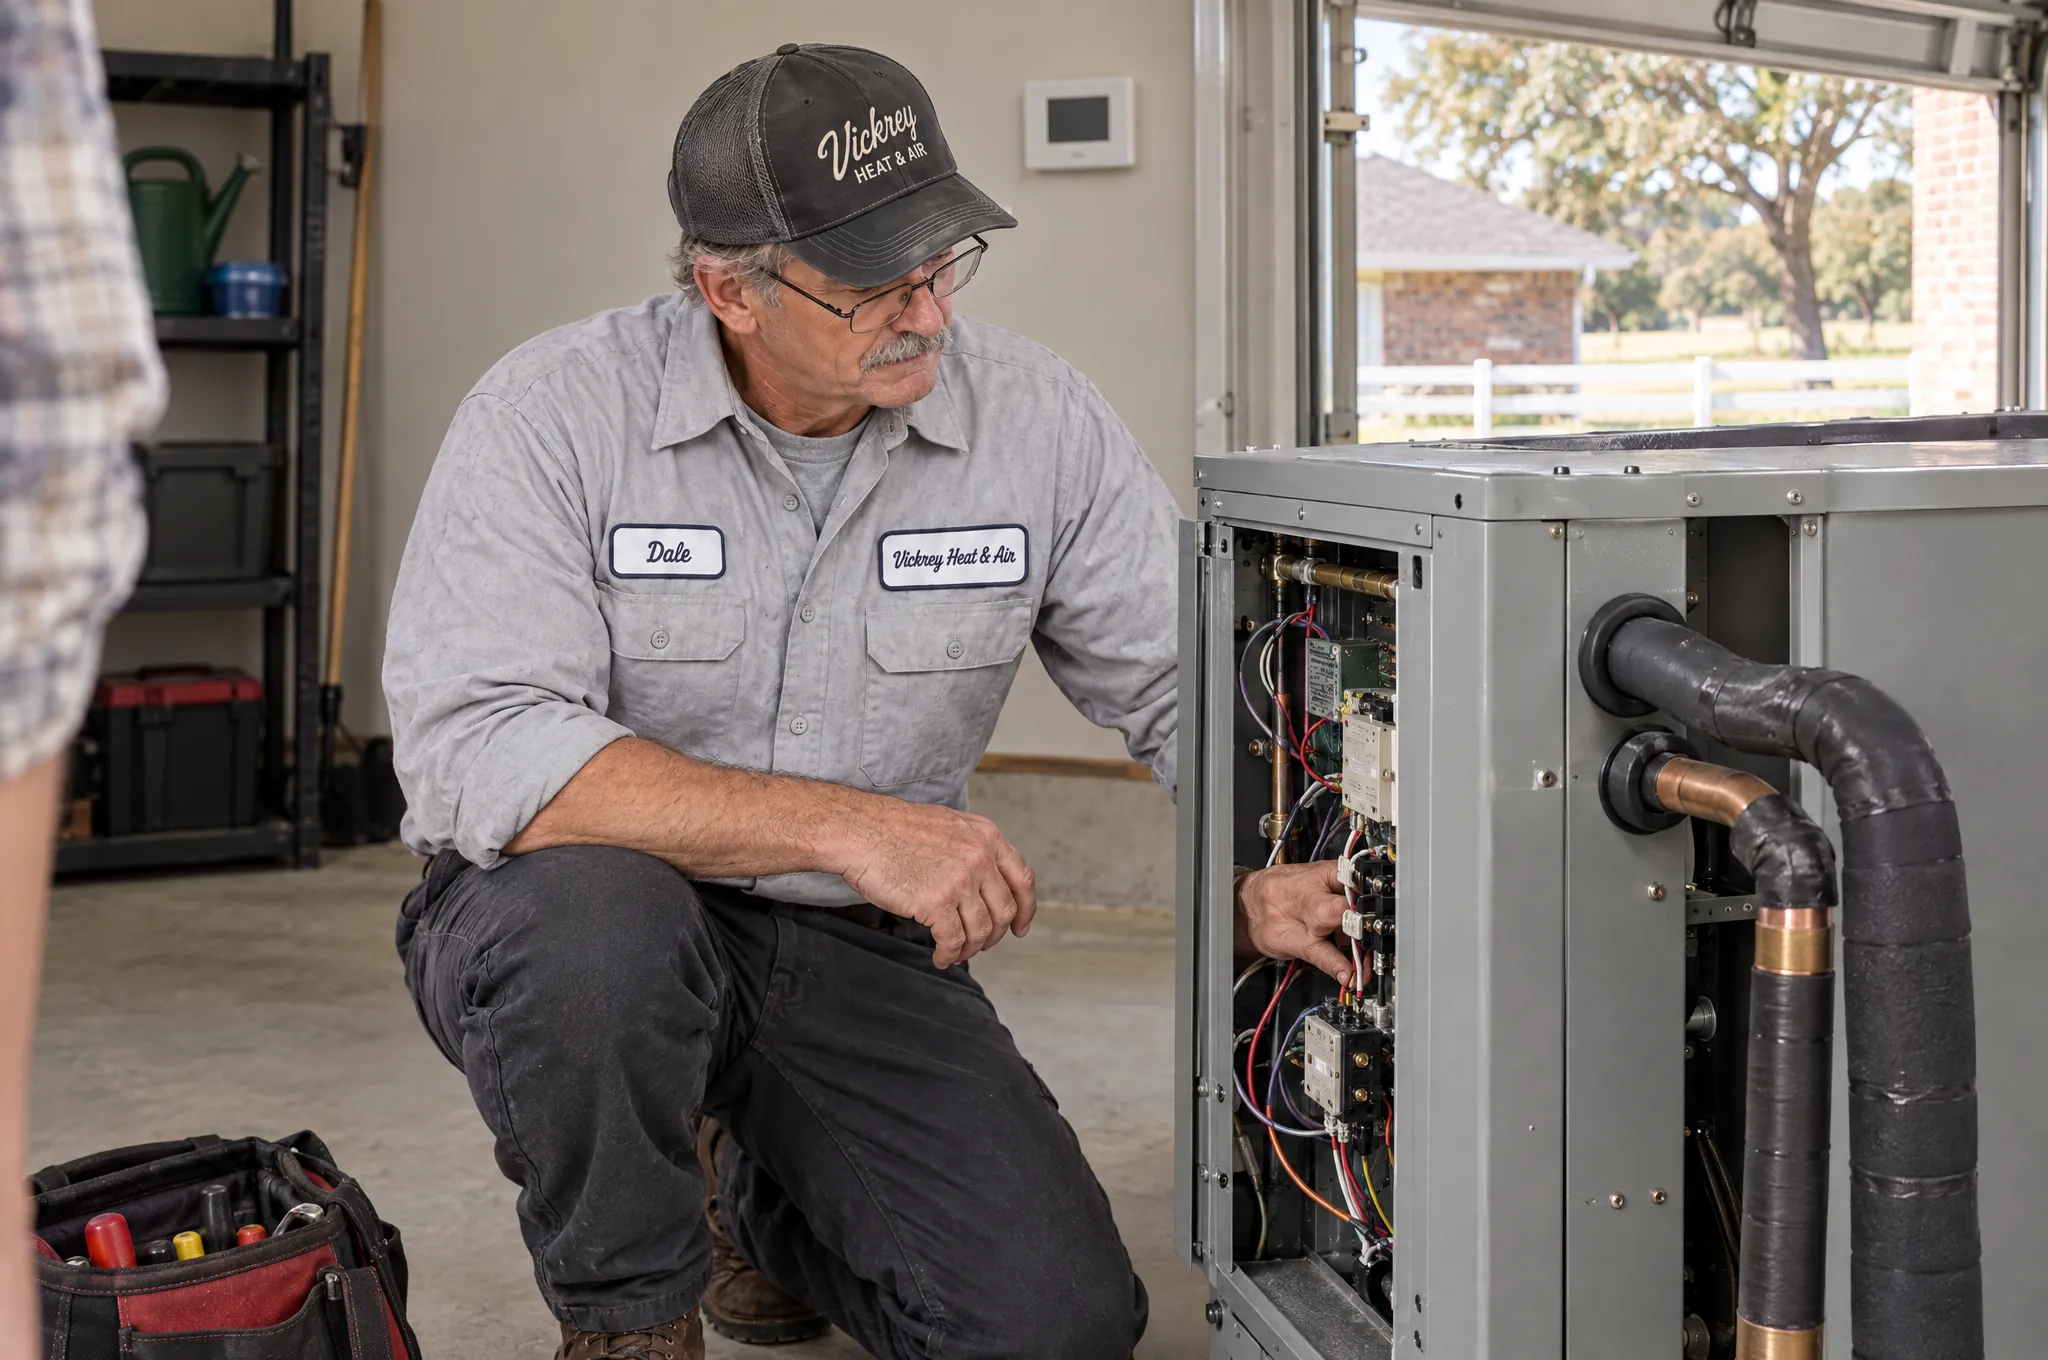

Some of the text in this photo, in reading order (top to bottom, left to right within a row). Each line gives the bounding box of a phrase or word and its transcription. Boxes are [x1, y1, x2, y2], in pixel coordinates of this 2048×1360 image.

[817, 105, 917, 182] Vickrey
[854, 142, 928, 184] HEAT & AIR
[646, 540, 692, 563] Dale
[893, 545, 1017, 573] Vickrey Heat & Air
